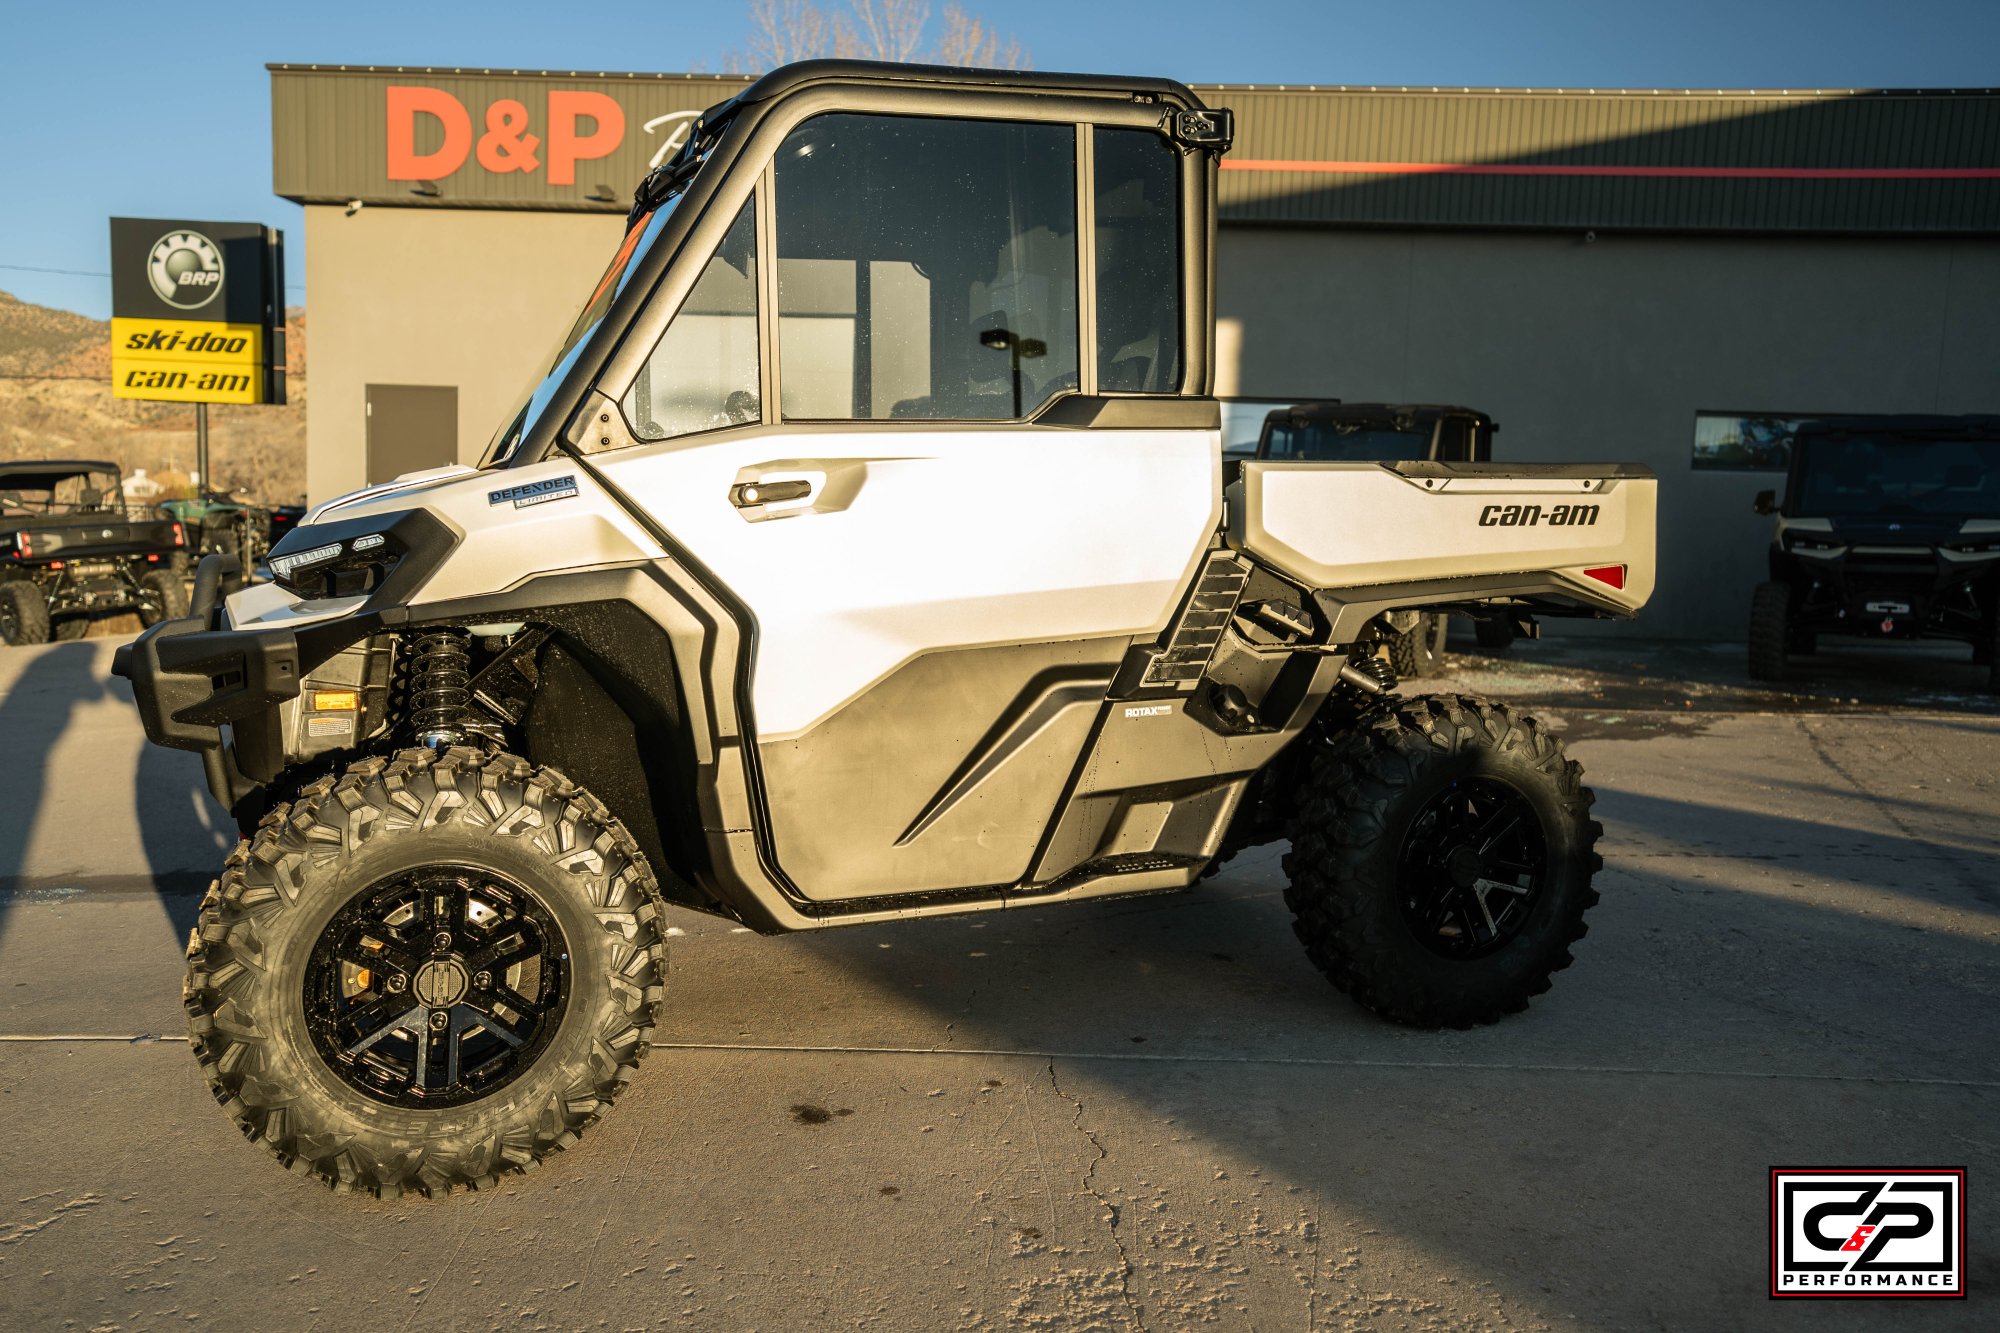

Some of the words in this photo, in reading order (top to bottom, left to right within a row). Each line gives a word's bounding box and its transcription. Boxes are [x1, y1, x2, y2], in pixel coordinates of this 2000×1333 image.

[387, 86, 626, 186] D&P
[177, 271, 220, 286] BRP
[126, 330, 248, 353] ski-doo
[125, 370, 250, 392] can-am
[490, 477, 575, 501] DEFENDER
[1478, 504, 1600, 526] can-am
[1125, 706, 1158, 718] ROTAX
